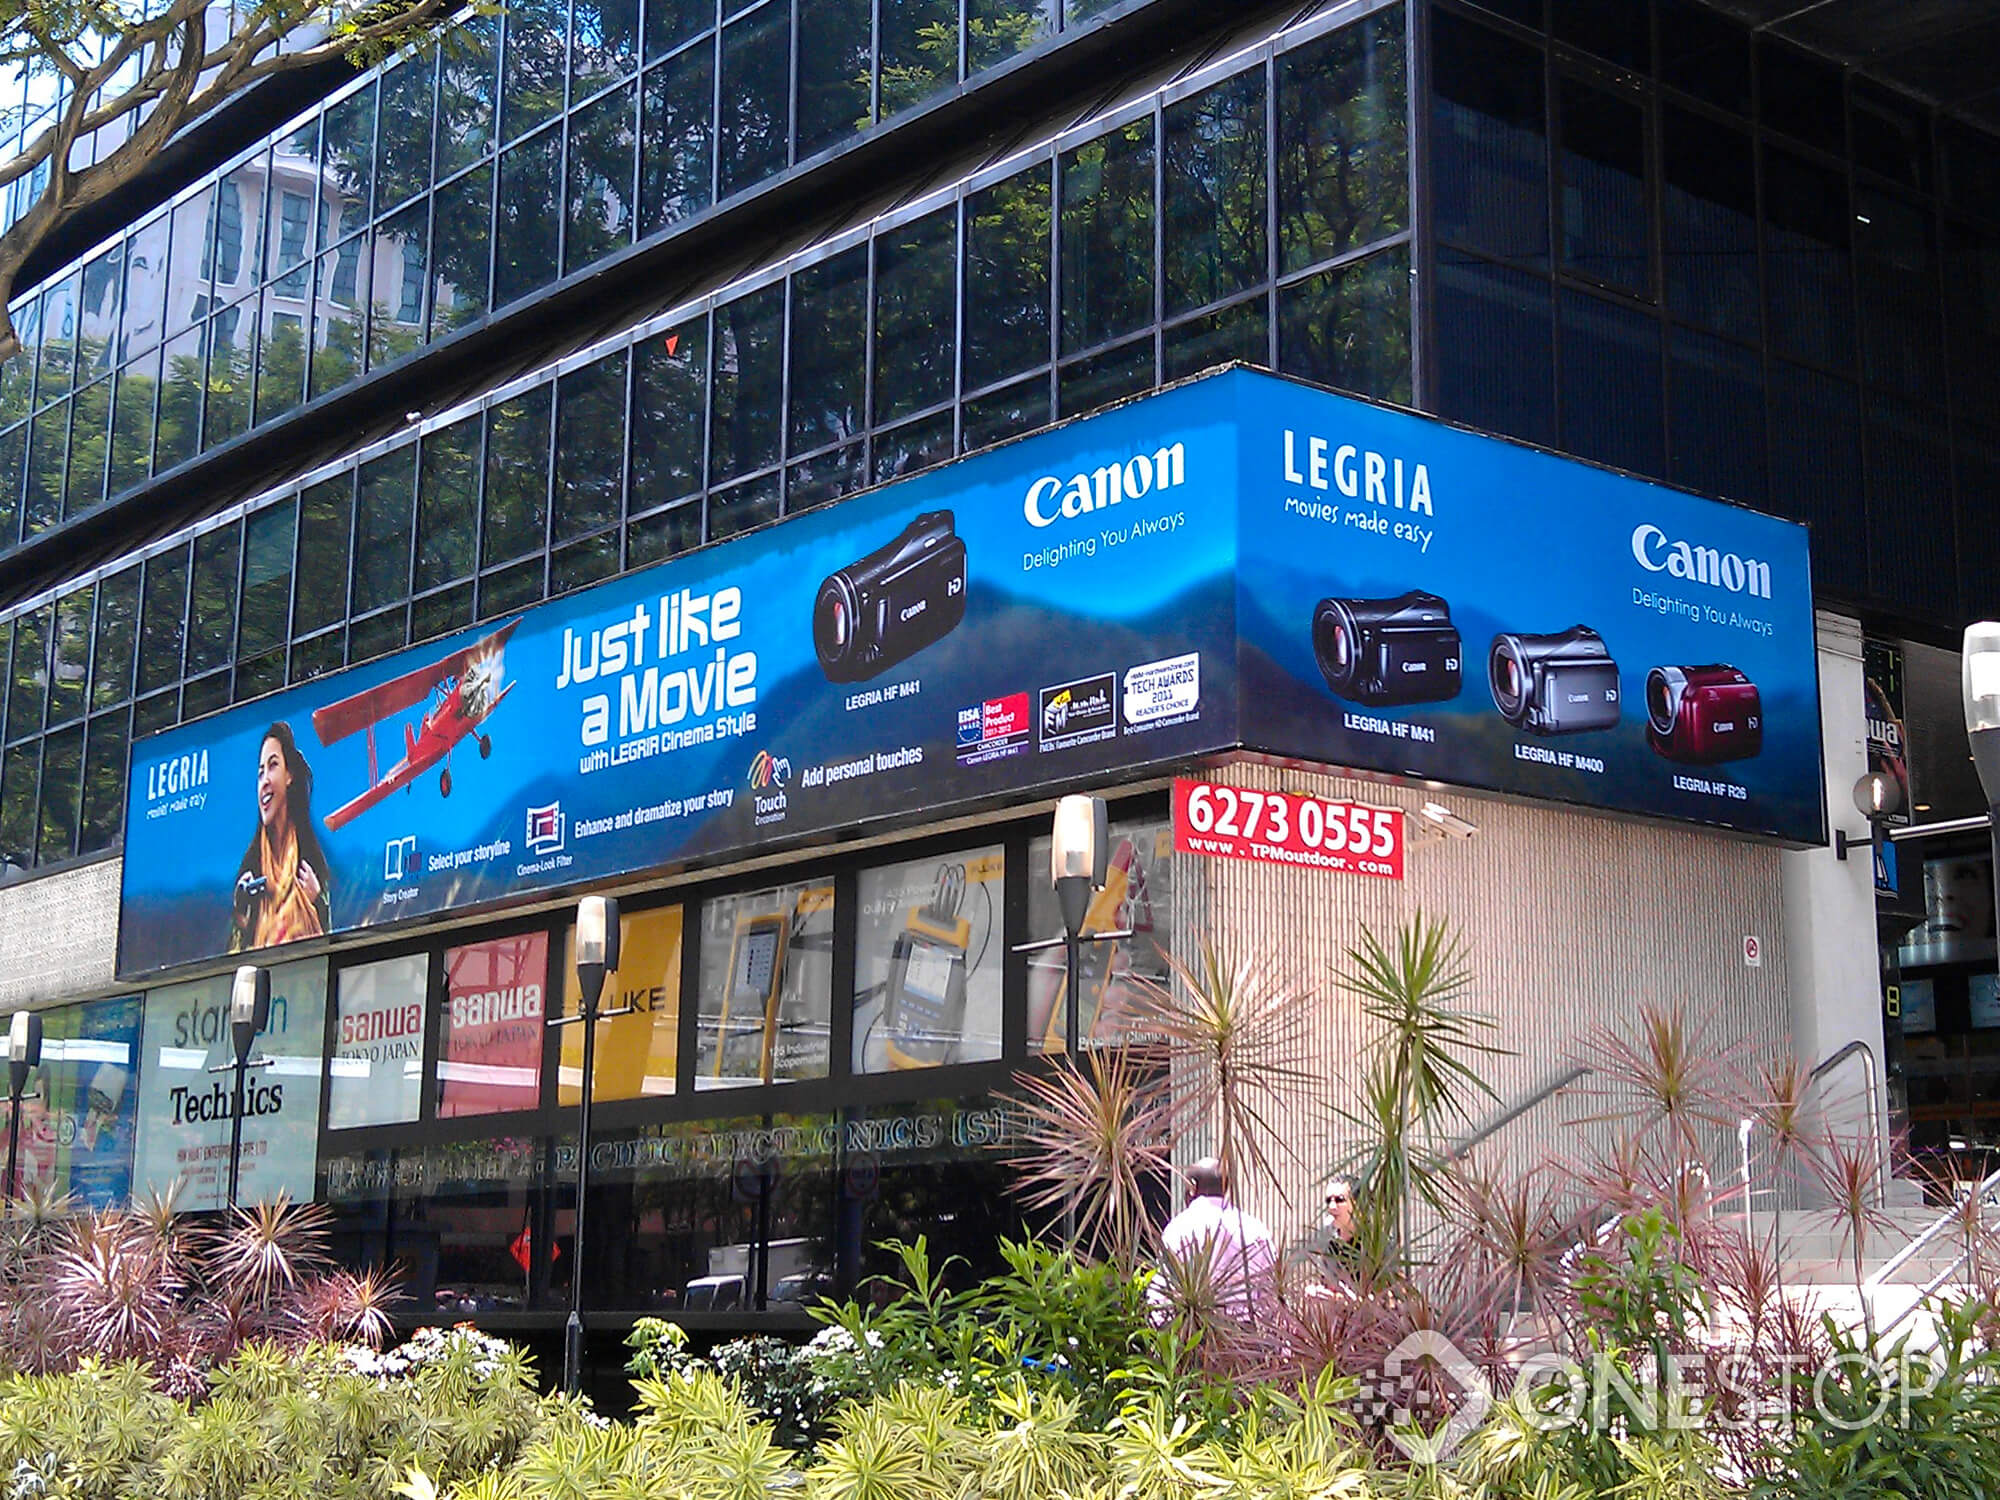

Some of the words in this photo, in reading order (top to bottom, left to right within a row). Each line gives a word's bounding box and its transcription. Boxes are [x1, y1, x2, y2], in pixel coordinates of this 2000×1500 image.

[1024, 442, 1185, 528] Canon
[1284, 430, 1433, 517] LEGRIA
[1285, 496, 1339, 523] movies
[1344, 510, 1388, 535] made
[1394, 522, 1433, 553] easy
[1023, 538, 1096, 571] Delighting
[1101, 528, 1127, 547] You
[1131, 512, 1185, 539] Always
[1632, 524, 1772, 599] Canon
[900, 599, 926, 622] Canon
[1632, 587, 1700, 622] Delighting
[1703, 605, 1727, 625] You
[1729, 612, 1774, 637] Always
[557, 603, 651, 689] Just
[658, 587, 742, 660] like
[1131, 677, 1156, 695] TECH
[1157, 668, 1194, 690] AWARDS
[1402, 661, 1428, 673] Canon
[580, 693, 610, 746] a
[618, 647, 758, 738] Movie
[845, 689, 883, 711] LEGRIA
[883, 685, 899, 701] HF
[899, 680, 921, 698] M41
[985, 703, 1002, 716] Best
[1152, 689, 1173, 703] 2011
[1568, 693, 1590, 703] Canon
[958, 707, 981, 724] EISA
[985, 712, 1015, 728] Product
[1344, 713, 1390, 735] LEGRIA
[1392, 722, 1409, 738] HF
[1411, 726, 1435, 743] M41
[579, 749, 609, 774] with
[610, 735, 660, 767] LEGRIA
[661, 723, 714, 753] Cinema
[716, 712, 757, 740] Style
[1514, 743, 1557, 765] LEGRIA
[1558, 752, 1575, 768] HF
[1575, 756, 1604, 773] M400
[147, 749, 209, 801] LEGRIA
[801, 766, 824, 788] Add
[826, 754, 874, 786] personal
[876, 746, 923, 771] touches
[1673, 775, 1712, 795] LEGRIA
[1712, 782, 1727, 796] HF
[575, 818, 613, 839] Enhance
[614, 811, 633, 829] and
[634, 803, 681, 826] dramatize
[683, 797, 705, 817] your
[707, 788, 735, 808] story
[755, 791, 787, 814] Touch
[1188, 785, 1289, 843] 6273
[1298, 800, 1395, 858] 0555
[428, 854, 453, 872] Select
[454, 850, 473, 869] your
[474, 839, 512, 862] storyline
[516, 858, 555, 877] Cinema-Look
[556, 854, 574, 869] Filter
[452, 983, 542, 1029] sanwa
[341, 1003, 422, 1045] sanwa
[341, 1045, 381, 1065] TOKYO
[382, 1040, 421, 1065] JAPAN
